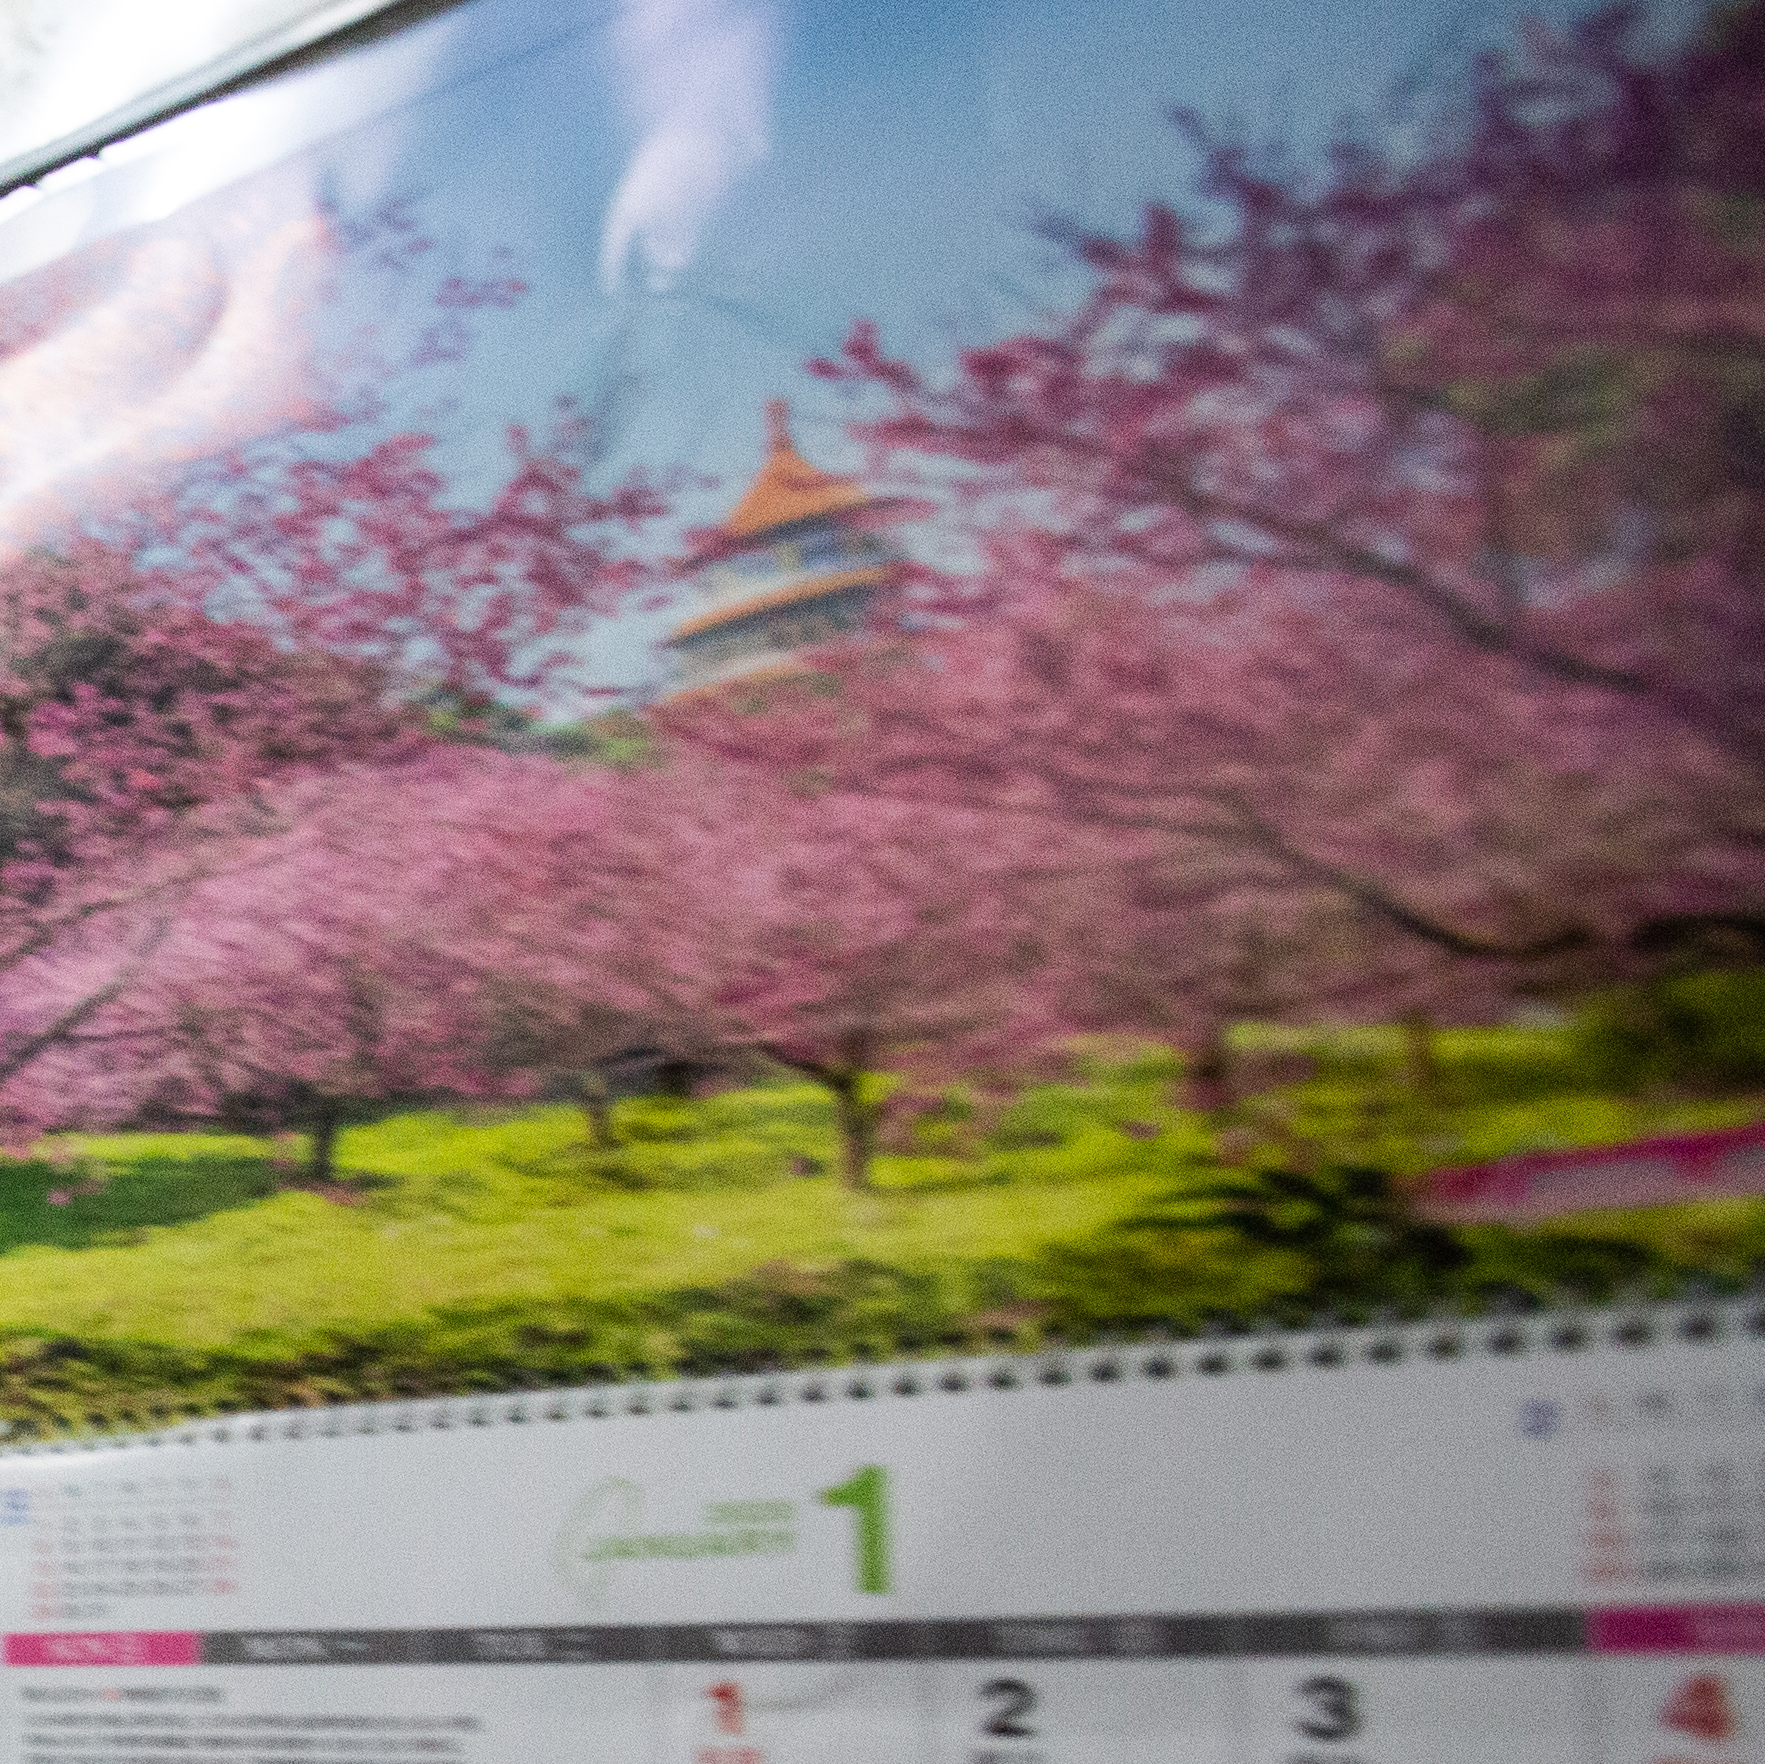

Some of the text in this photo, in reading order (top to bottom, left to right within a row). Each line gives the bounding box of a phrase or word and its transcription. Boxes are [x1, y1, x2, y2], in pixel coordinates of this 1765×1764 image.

[820, 1465, 892, 1595] 1
[705, 1673, 1738, 1744] 1 2 3 4
